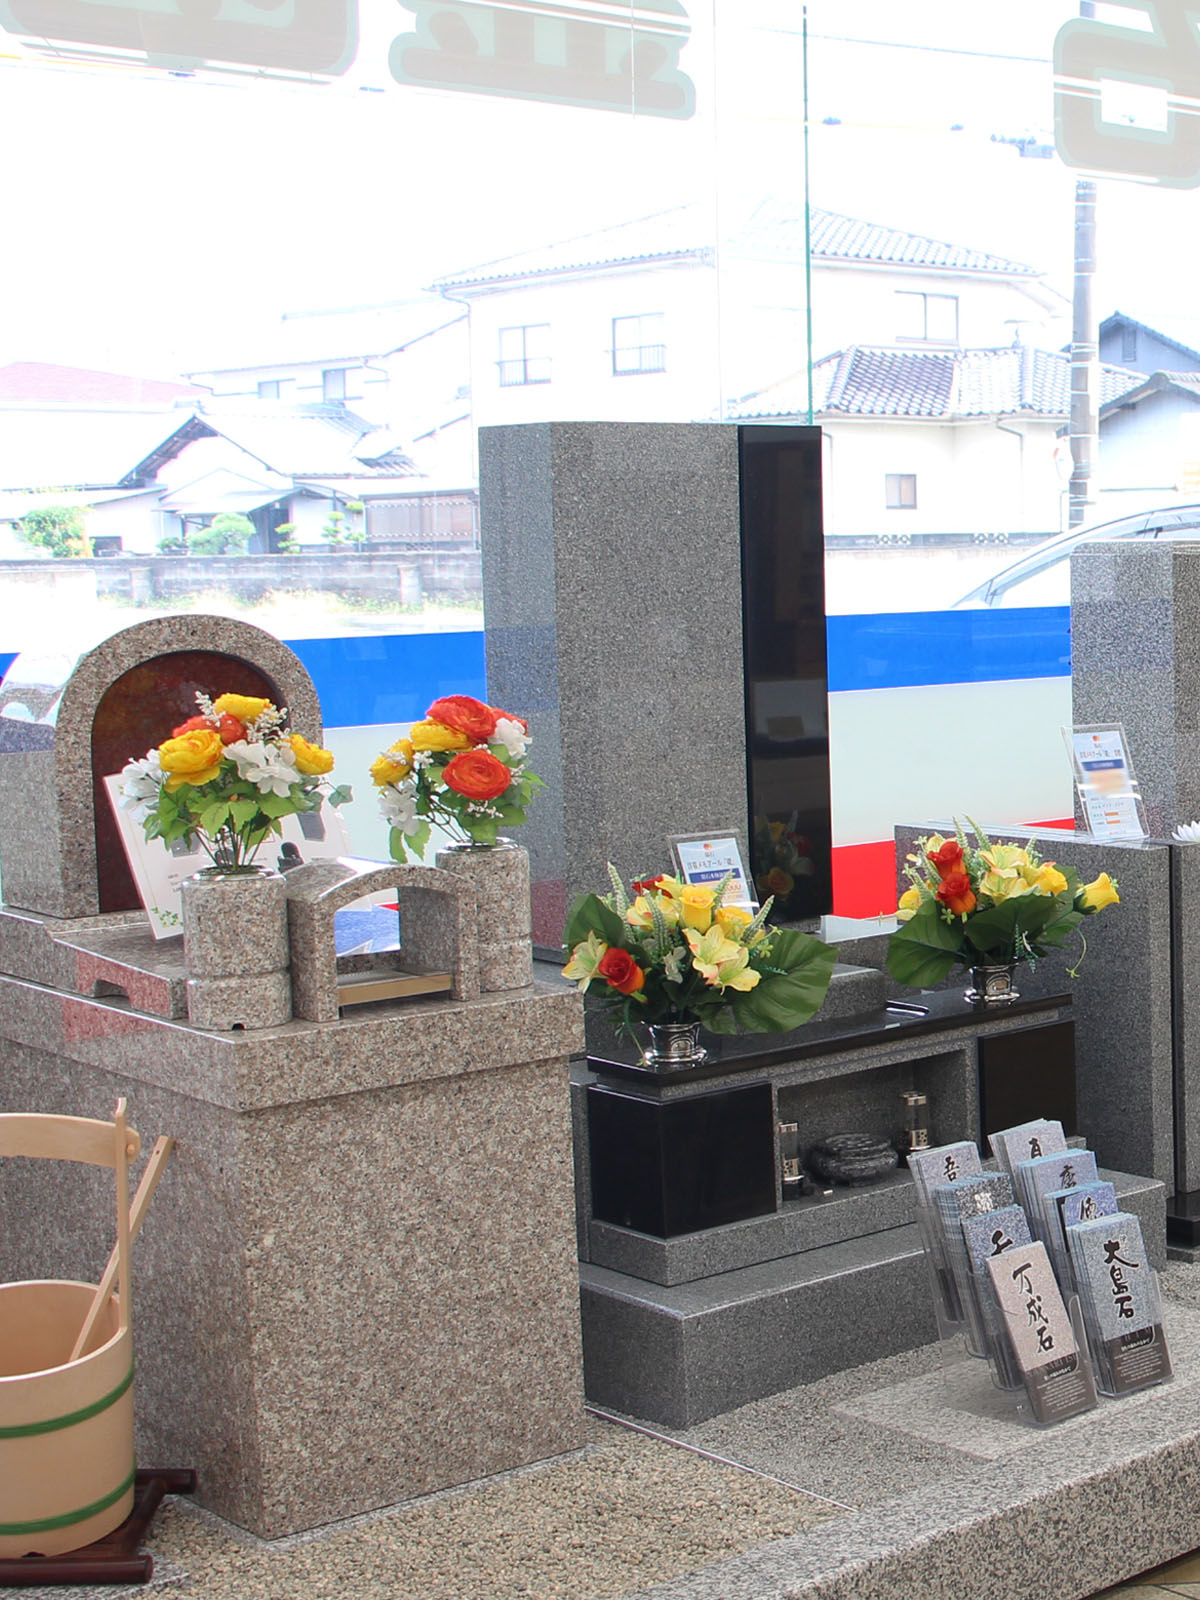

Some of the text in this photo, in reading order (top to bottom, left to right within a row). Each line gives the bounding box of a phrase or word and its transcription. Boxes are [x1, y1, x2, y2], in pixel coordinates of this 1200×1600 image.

[1011, 1261, 1056, 1355] 万成石
[1103, 1239, 1139, 1319] 大島石
